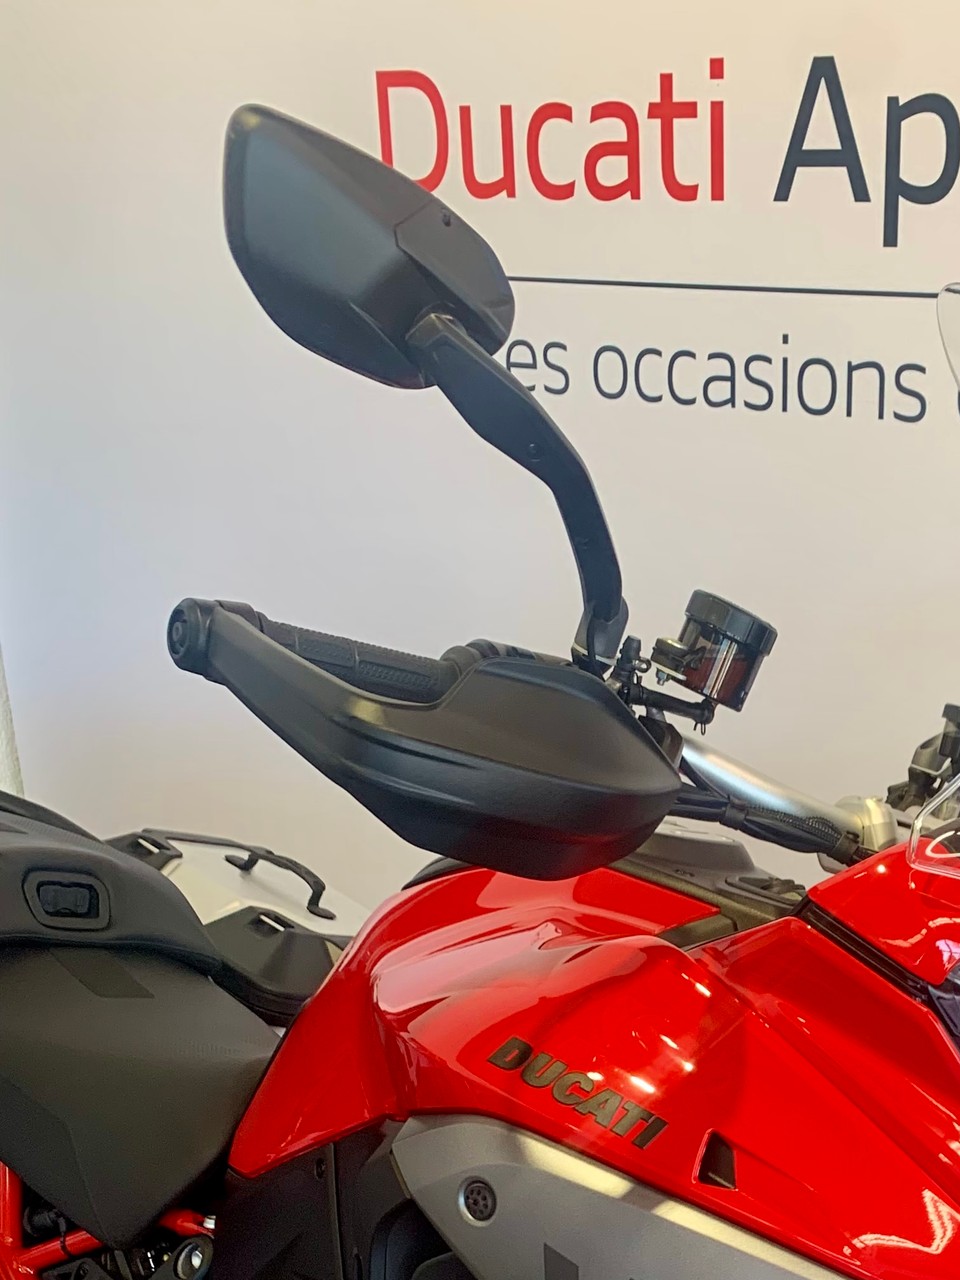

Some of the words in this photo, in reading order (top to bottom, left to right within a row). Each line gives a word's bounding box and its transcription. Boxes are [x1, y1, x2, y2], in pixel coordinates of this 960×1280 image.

[375, 57, 725, 202] Ducati
[505, 338, 570, 395] es
[592, 333, 928, 423] occasions
[487, 1036, 669, 1150] DUCATI
